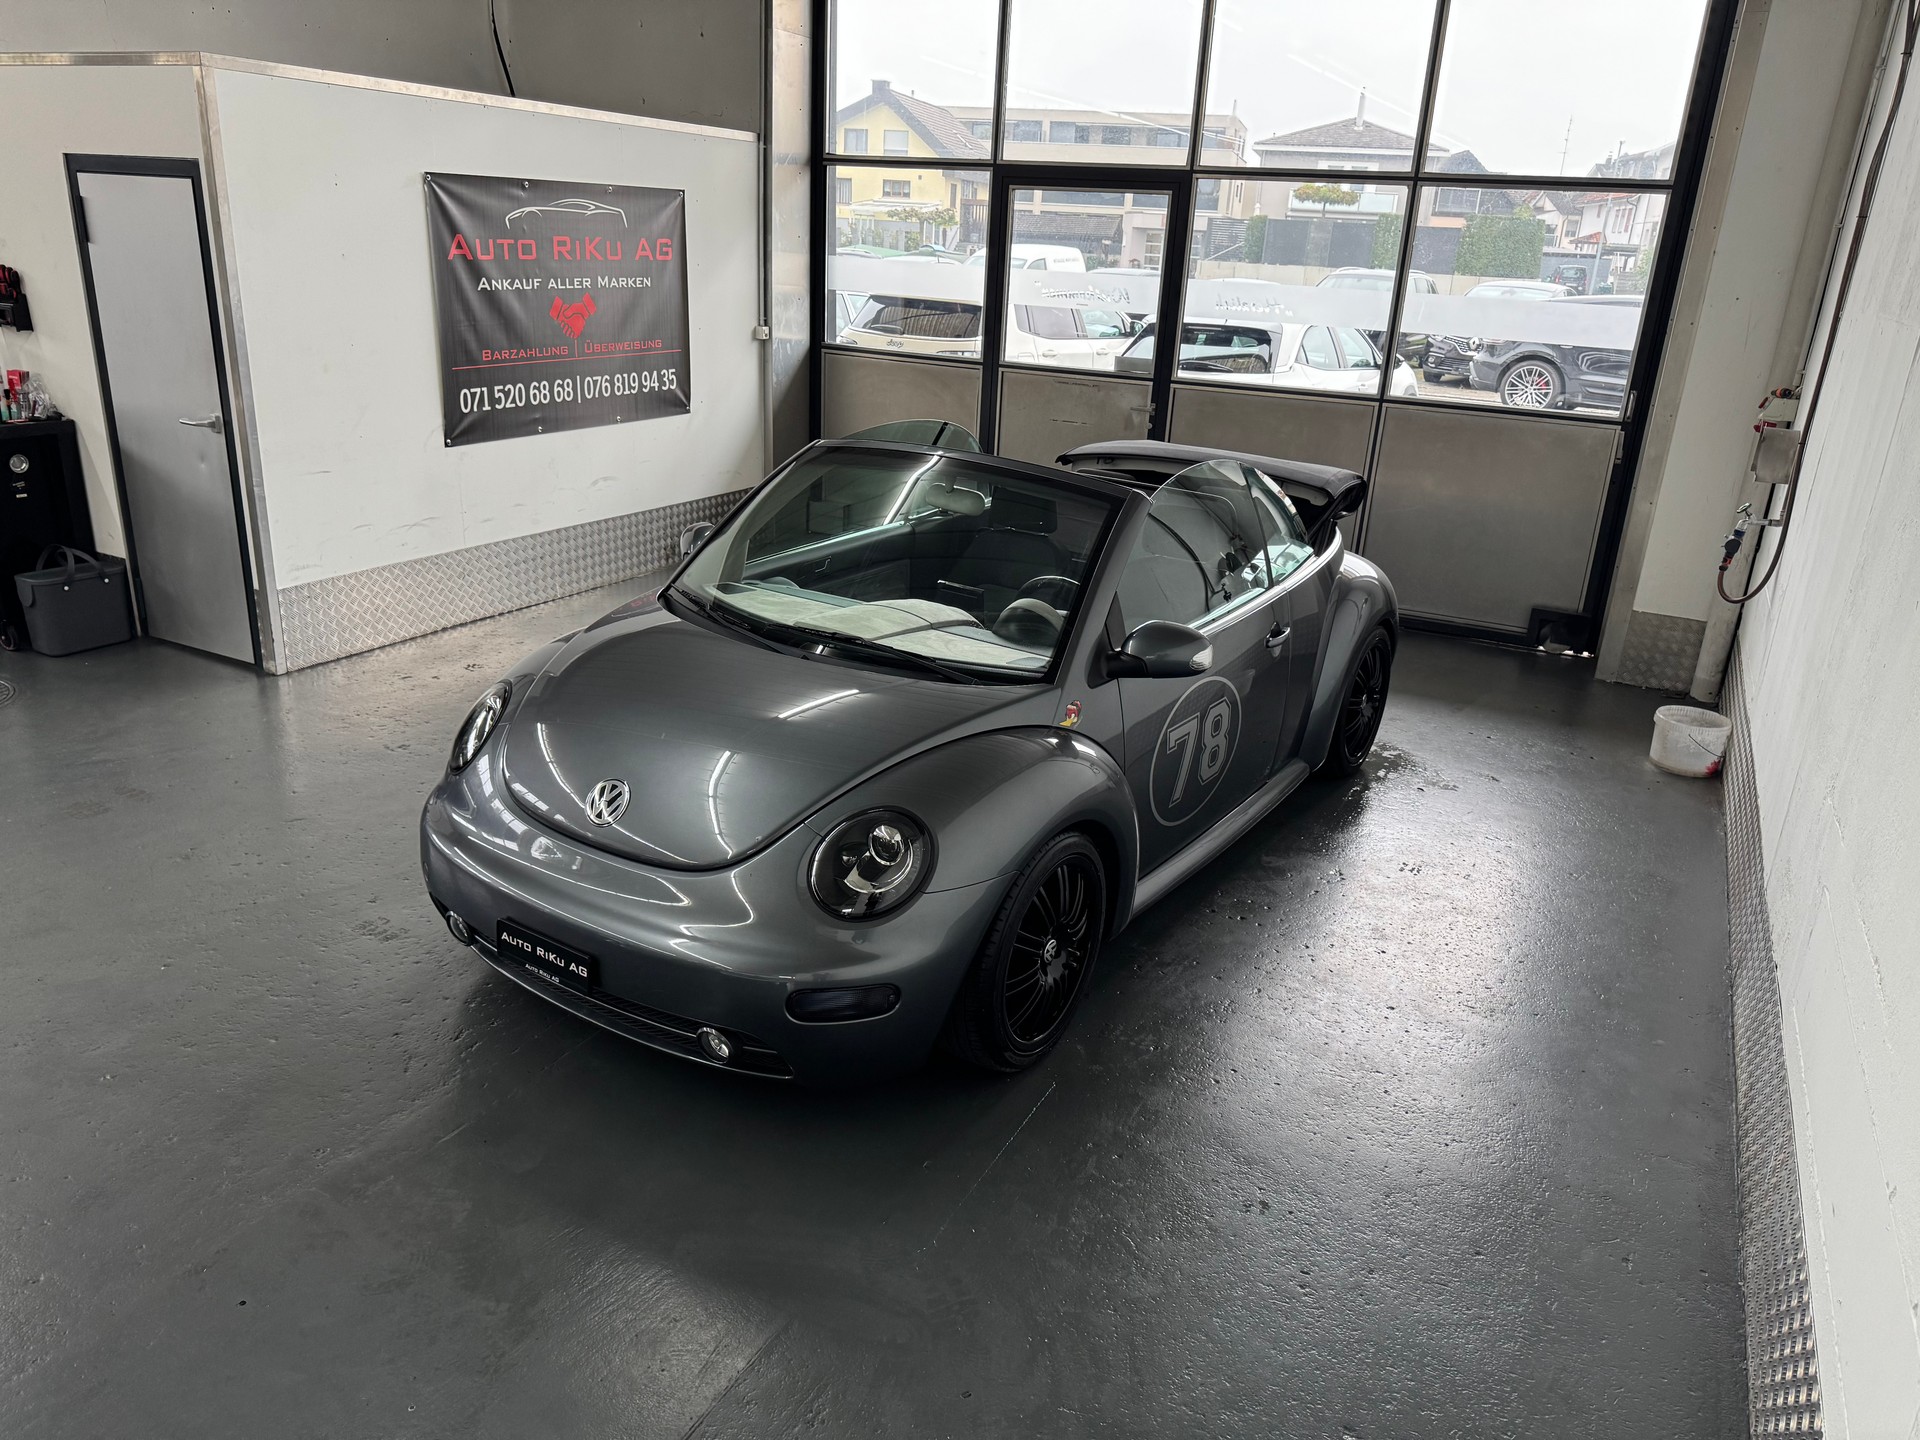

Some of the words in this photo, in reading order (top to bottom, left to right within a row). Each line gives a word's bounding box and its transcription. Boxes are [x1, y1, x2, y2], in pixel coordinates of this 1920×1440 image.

[448, 233, 538, 261] AUTO
[634, 238, 673, 261] AG
[477, 276, 542, 291] ANKAUF
[547, 276, 592, 289] ALLER
[597, 275, 651, 289] MARKEN
[481, 345, 569, 361] BARZAHLUNG
[584, 339, 662, 354] ÜBERWEISUNG
[459, 386, 492, 414] 071
[494, 382, 526, 410] 520
[529, 380, 551, 406] 68
[553, 378, 574, 403] 68
[584, 374, 611, 399] 076
[614, 371, 639, 396] 819
[642, 370, 659, 393] 94
[660, 368, 677, 390] 35
[1166, 696, 1232, 808] 78
[588, 780, 629, 825] VW
[501, 931, 532, 952] AUTO
[569, 962, 588, 978] AG
[551, 973, 560, 983] AG
